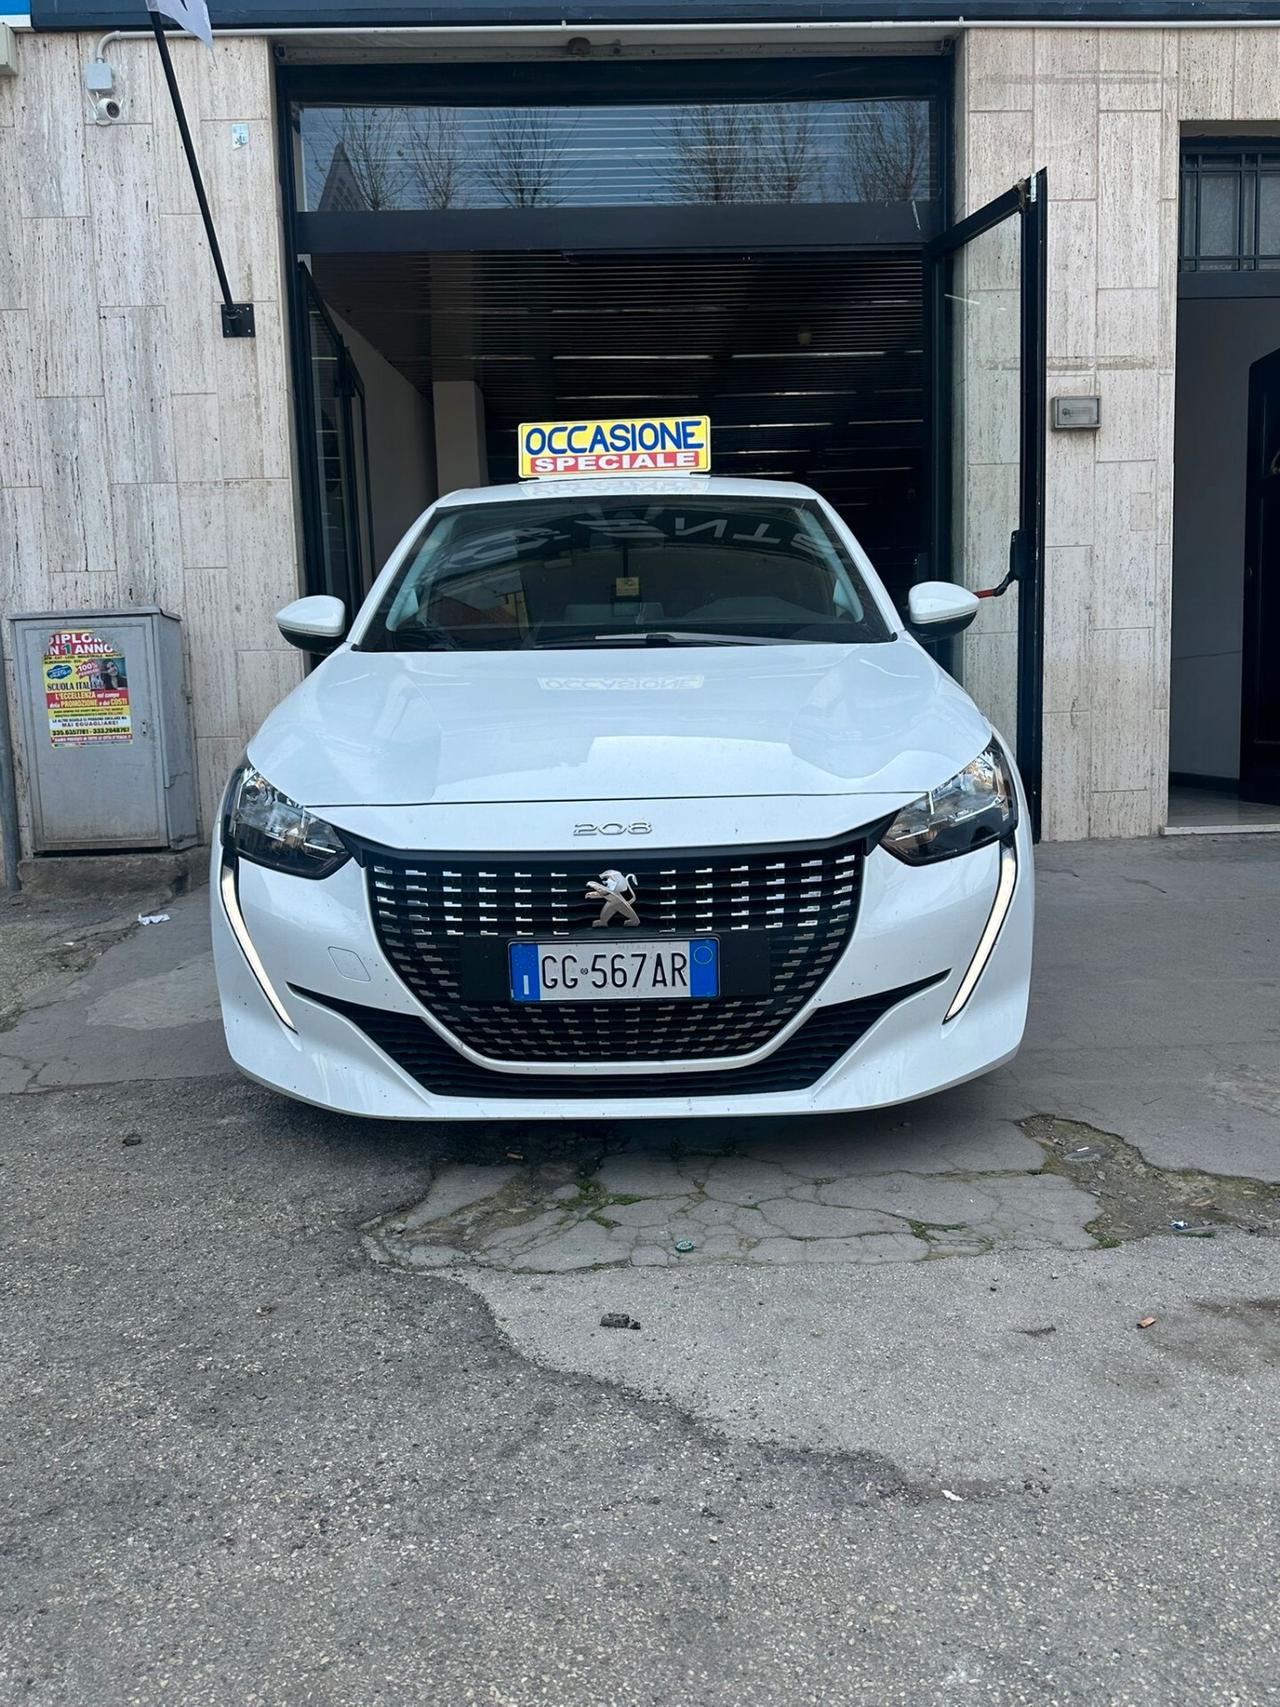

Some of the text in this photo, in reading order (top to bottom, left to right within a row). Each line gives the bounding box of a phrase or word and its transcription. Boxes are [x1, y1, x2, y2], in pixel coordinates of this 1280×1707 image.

[525, 421, 704, 455] OCCASIONE
[534, 452, 696, 472] SPECIALE
[47, 682, 75, 691] SCUOLA
[573, 821, 653, 837] 208
